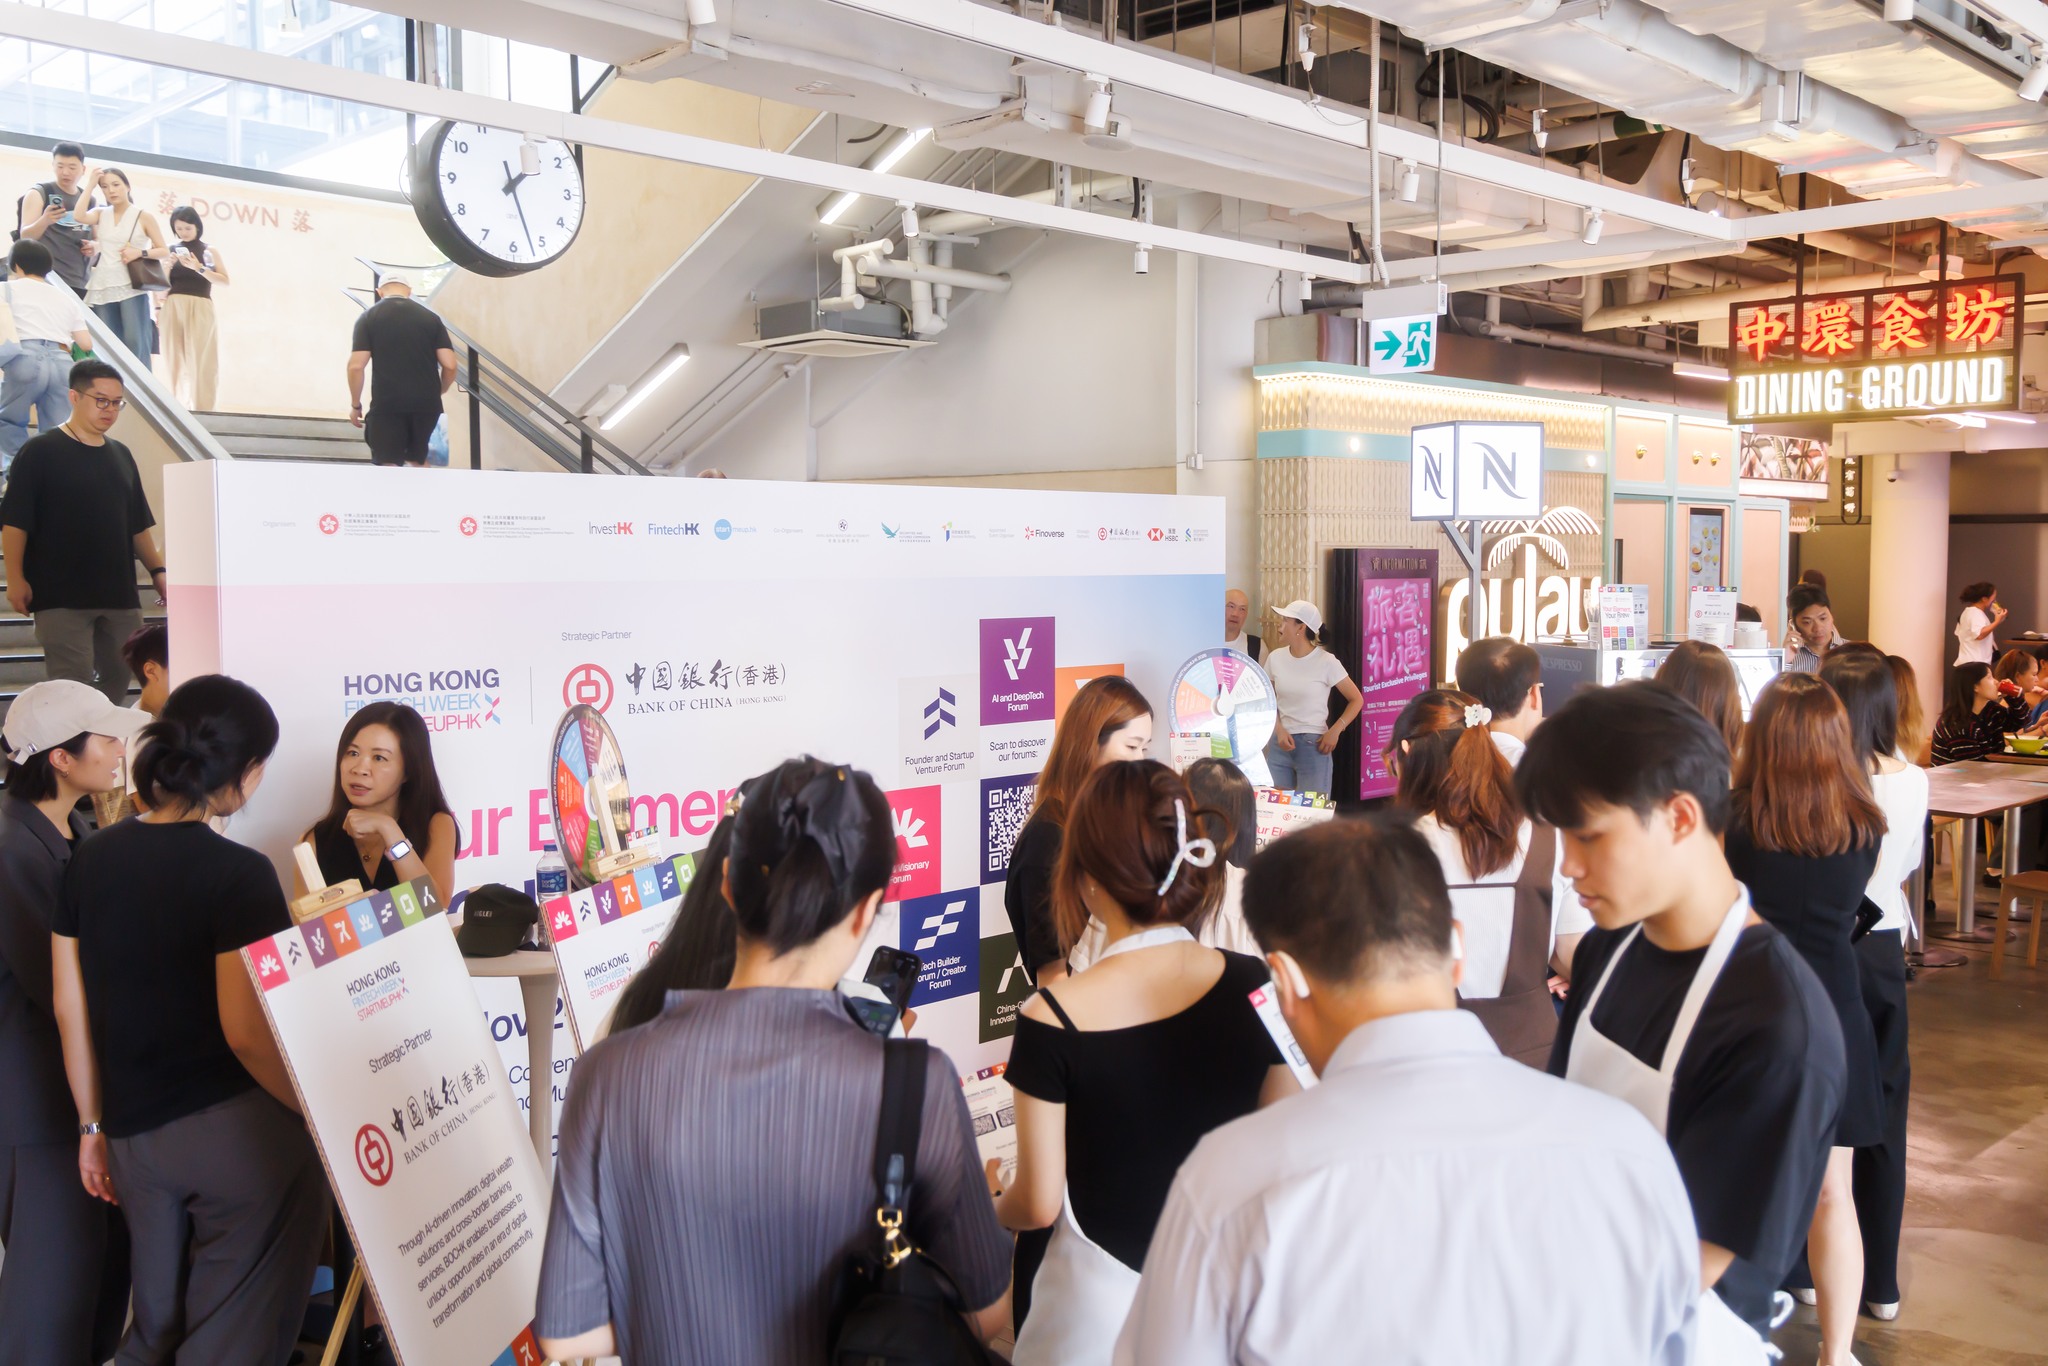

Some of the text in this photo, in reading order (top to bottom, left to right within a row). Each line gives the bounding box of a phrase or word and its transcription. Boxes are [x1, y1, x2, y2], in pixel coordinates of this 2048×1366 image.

[454, 140, 468, 154] 10
[554, 156, 562, 168] 2
[446, 172, 457, 184] 9
[563, 189, 572, 200] 3
[190, 196, 279, 228] DOWN
[292, 208, 314, 232] 落
[457, 203, 466, 216] 8
[556, 216, 565, 228] 4
[481, 228, 490, 241] 7
[509, 241, 518, 252] 6
[538, 236, 546, 248] 5
[1736, 288, 2008, 362] 中環食坊
[1737, 357, 2004, 416] DINING GROUND
[588, 522, 634, 534] InvestHK
[648, 522, 700, 536] FintechHK
[1035, 530, 1064, 538] Finoverse
[1381, 558, 1418, 570] INFORMATION
[1366, 580, 1421, 633] 旅客
[561, 630, 632, 642] Strategic Partner
[1369, 628, 1424, 681] 礼遇
[344, 668, 500, 696] HONG KONG
[626, 658, 786, 696] 中國銀行(香港)
[1364, 671, 1428, 693] Tourist Exclusive Privileges
[428, 692, 480, 712] WEEK
[992, 691, 1044, 703] AI and DeepTech
[628, 701, 665, 714] BANK
[670, 700, 686, 711] OF
[690, 697, 733, 710] CHINA
[1008, 703, 1028, 712] Forum
[424, 713, 482, 732] EUPHK
[1374, 722, 1376, 730] 1
[990, 738, 1046, 752] Scan to discover
[1366, 745, 1370, 756] 2
[905, 751, 974, 766] Founder and Startup
[998, 750, 1038, 762] our forums:
[915, 762, 965, 775] Venture Forum
[899, 860, 930, 872] Visionary
[584, 953, 630, 980] HONG KONG
[937, 956, 961, 968] Builder
[346, 960, 401, 996] HONG KONG
[918, 972, 936, 982] orum
[942, 965, 967, 976] Creator
[929, 978, 952, 990] Forum
[352, 976, 400, 1010] FINTECH WEEK
[357, 991, 404, 1022] STARTMEUPHK
[368, 1028, 432, 1074] Strategic Partner
[404, 1137, 430, 1164] BANK
[428, 1131, 442, 1148] OF
[441, 1112, 468, 1137] CHINA
[398, 1156, 514, 1256] Through AI-driven innovation, digital wealth
[417, 1239, 445, 1267] solutions
[456, 1200, 490, 1234] cross-border
[490, 1180, 513, 1206] banking
[418, 1265, 445, 1292] services,
[443, 1240, 468, 1269] BOCHK
[466, 1223, 489, 1249] enables
[487, 1200, 518, 1228] businesses
[427, 1284, 448, 1309] unlock
[448, 1250, 484, 1290] opportunities
[511, 1209, 528, 1232] digital
[432, 1281, 476, 1328] transformation
[486, 1254, 504, 1281] global
